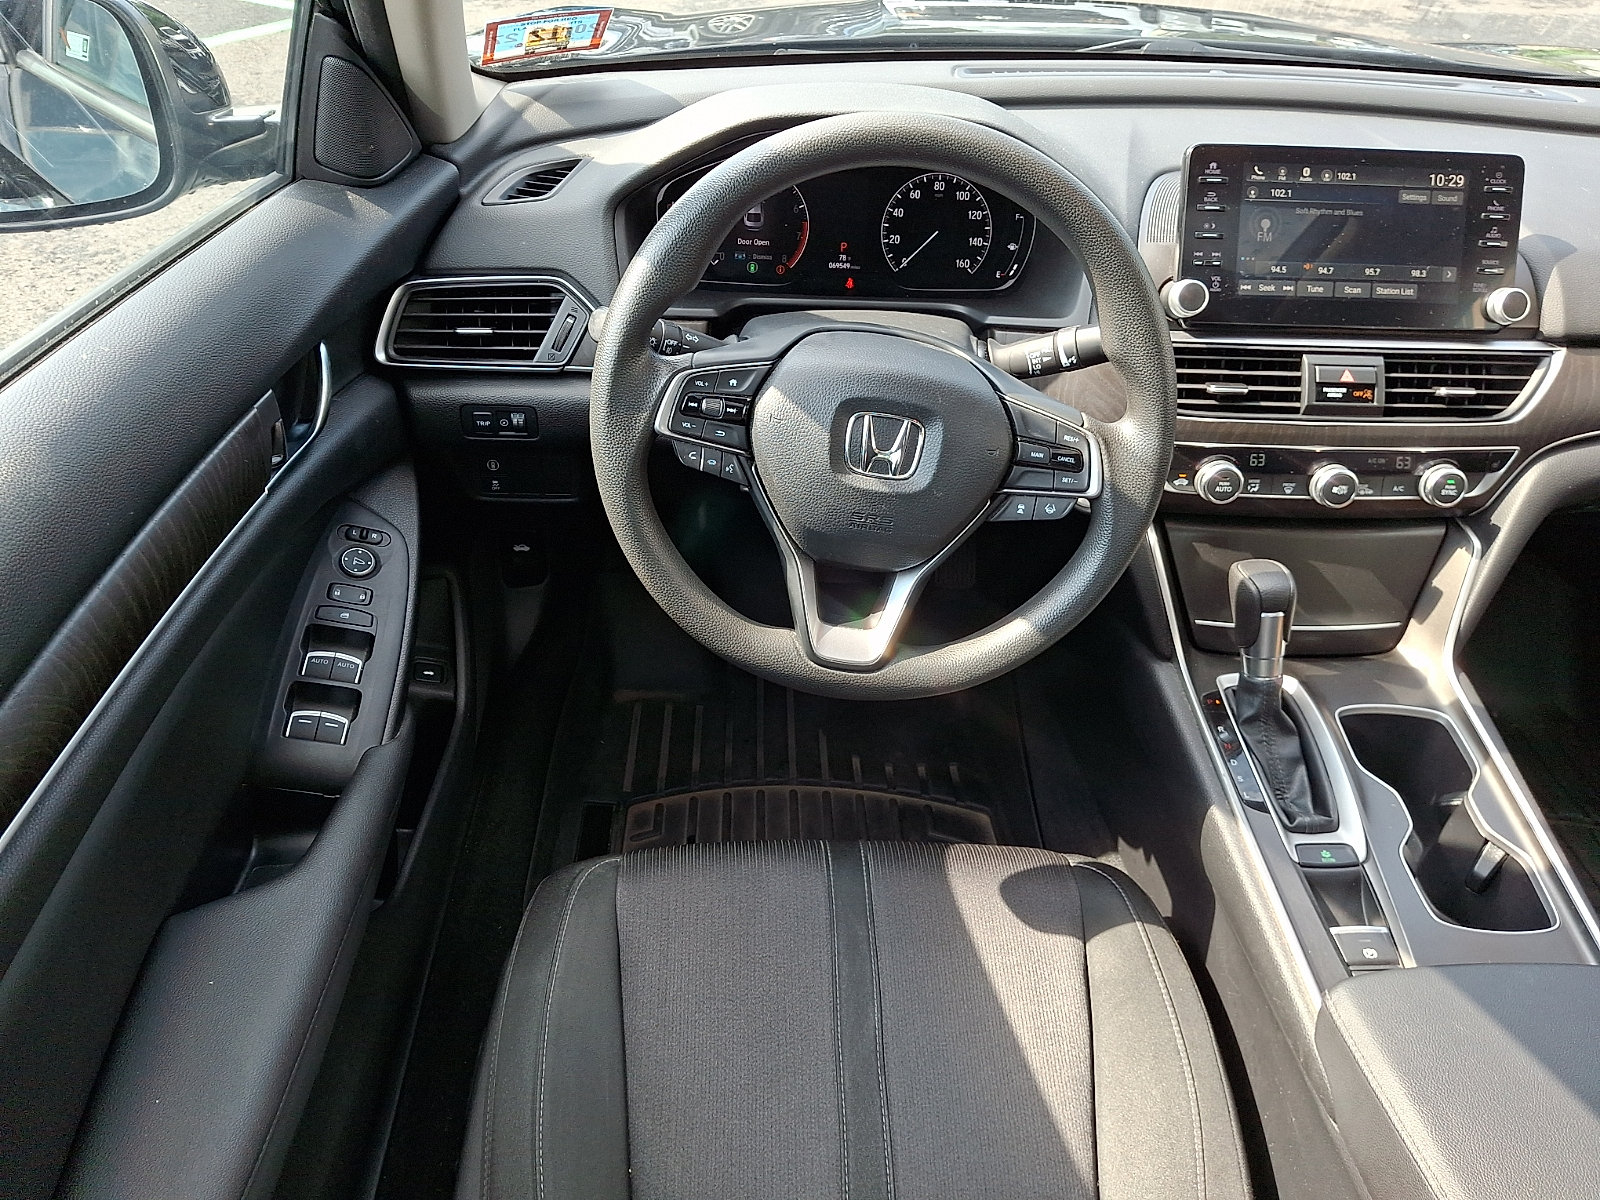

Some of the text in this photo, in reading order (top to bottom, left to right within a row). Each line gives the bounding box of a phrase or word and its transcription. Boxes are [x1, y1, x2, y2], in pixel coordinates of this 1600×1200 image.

[1337, 172, 1357, 181] 102.1
[1429, 173, 1465, 187] 10:29
[934, 181, 945, 191] 80
[909, 189, 921, 200] 60
[956, 191, 971, 201] 100
[1270, 188, 1292, 198] 102.1
[1402, 193, 1428, 202] Settings
[1438, 194, 1459, 202] Sound
[793, 204, 799, 213] 6
[893, 208, 904, 218] 40
[968, 210, 982, 220] 120
[889, 234, 900, 244] 20
[1257, 231, 1273, 242] FM
[737, 237, 770, 247] Door Open
[969, 237, 983, 247] 140
[840, 242, 847, 252] P
[956, 259, 970, 269] 160
[995, 270, 1001, 278] E
[1270, 265, 1287, 274] 94.5
[1317, 266, 1334, 275] 94.7
[1364, 267, 1381, 276] 95.7
[1410, 269, 1427, 278] 98.3
[1258, 283, 1276, 292] Seek
[1306, 284, 1324, 293] Tune
[1343, 286, 1362, 294] Scan
[1376, 286, 1415, 296] Station List
[1031, 451, 1044, 459] MAIN
[1057, 455, 1076, 464] CANCEL
[1249, 453, 1266, 467] 63
[1395, 456, 1412, 470] 63
[311, 657, 329, 665] AUTO
[337, 661, 355, 670] AUTO
[1217, 725, 1224, 733] R
[1237, 775, 1244, 783] S
[1243, 791, 1250, 799] L
